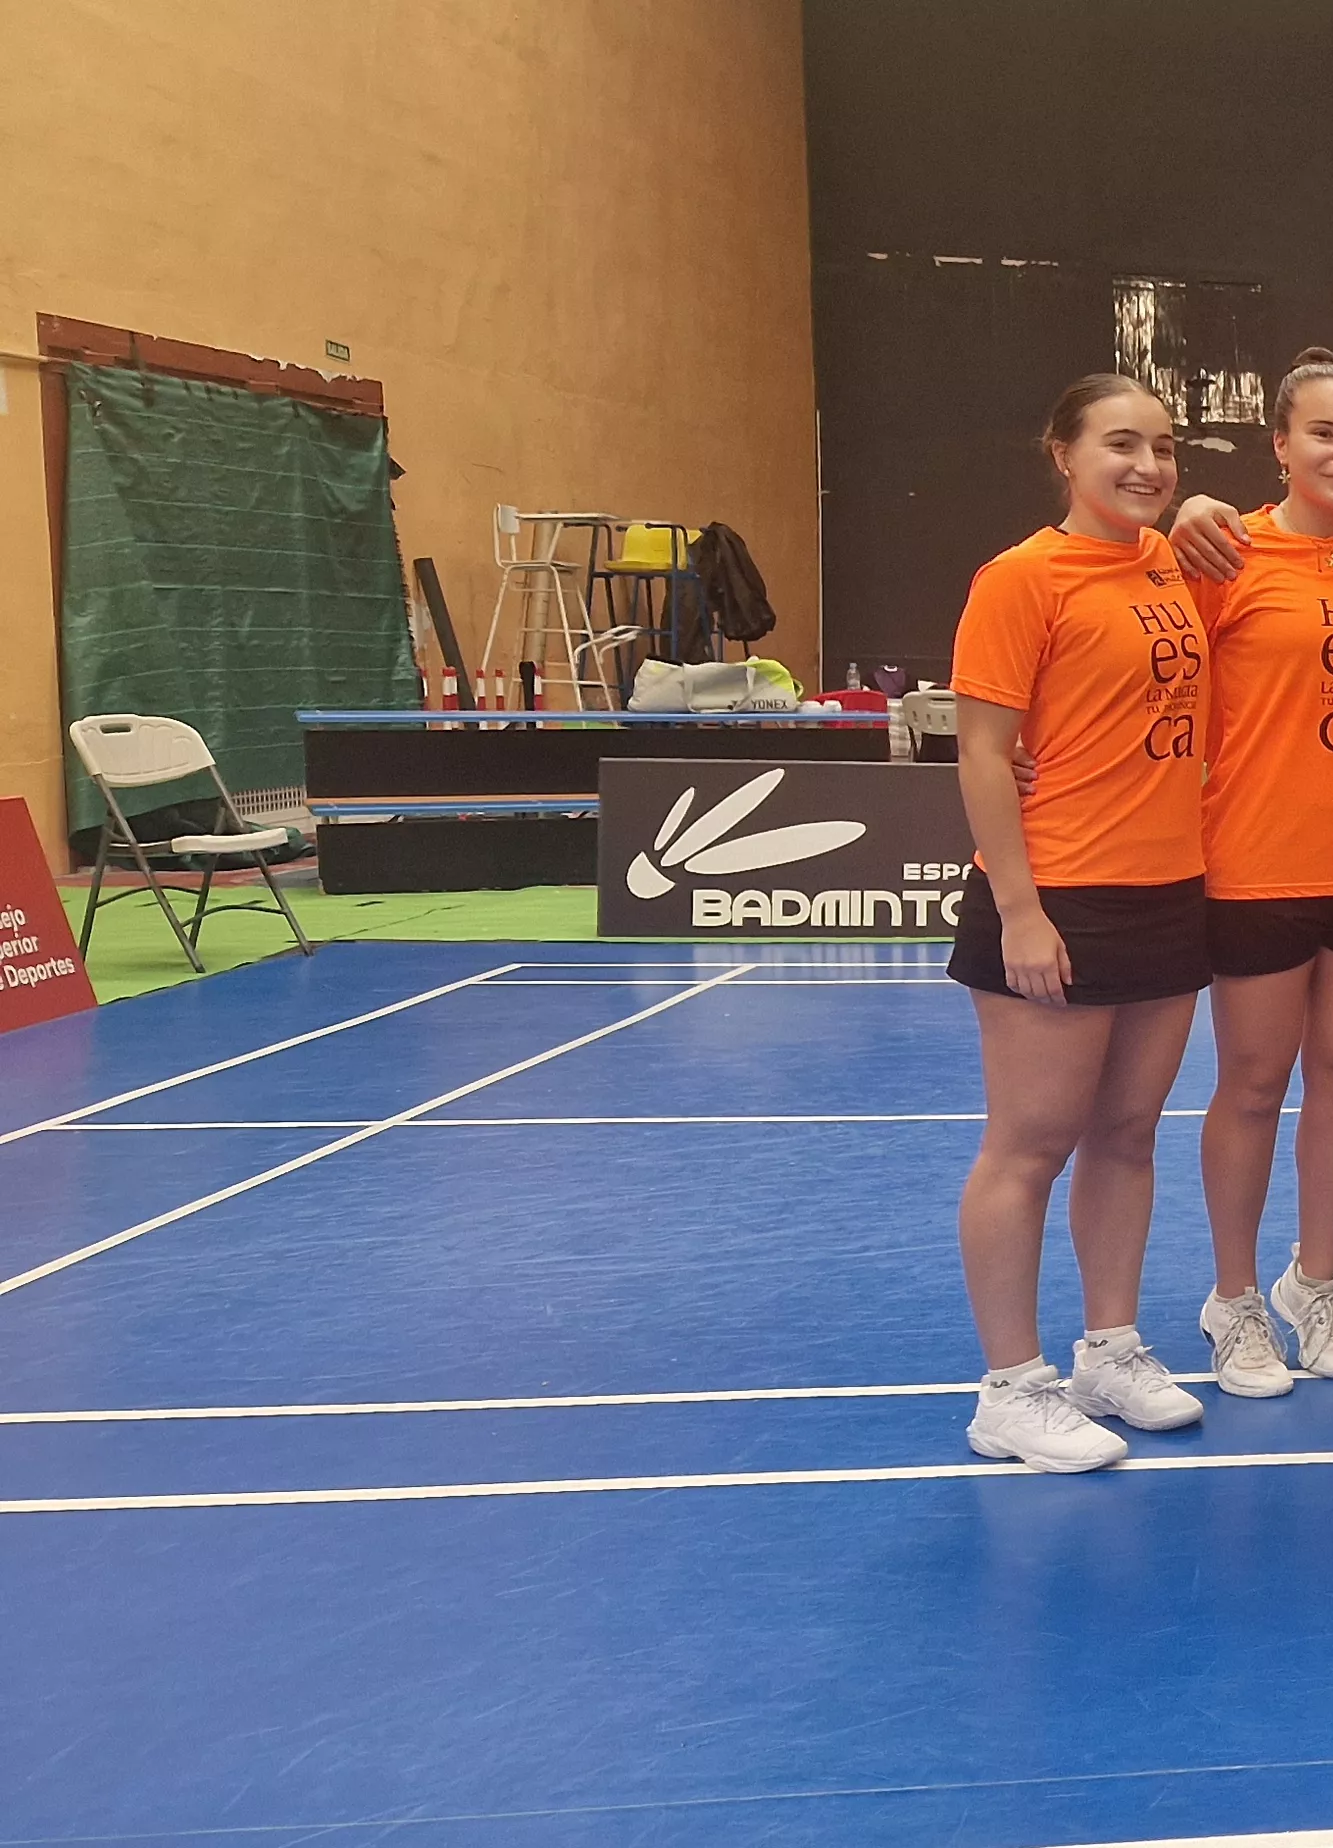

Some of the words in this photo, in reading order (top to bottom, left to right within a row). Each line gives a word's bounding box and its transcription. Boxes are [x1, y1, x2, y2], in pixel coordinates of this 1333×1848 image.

[1151, 633, 1202, 684] es
[750, 699, 788, 709] YONEX
[3, 957, 76, 988] Deportes
